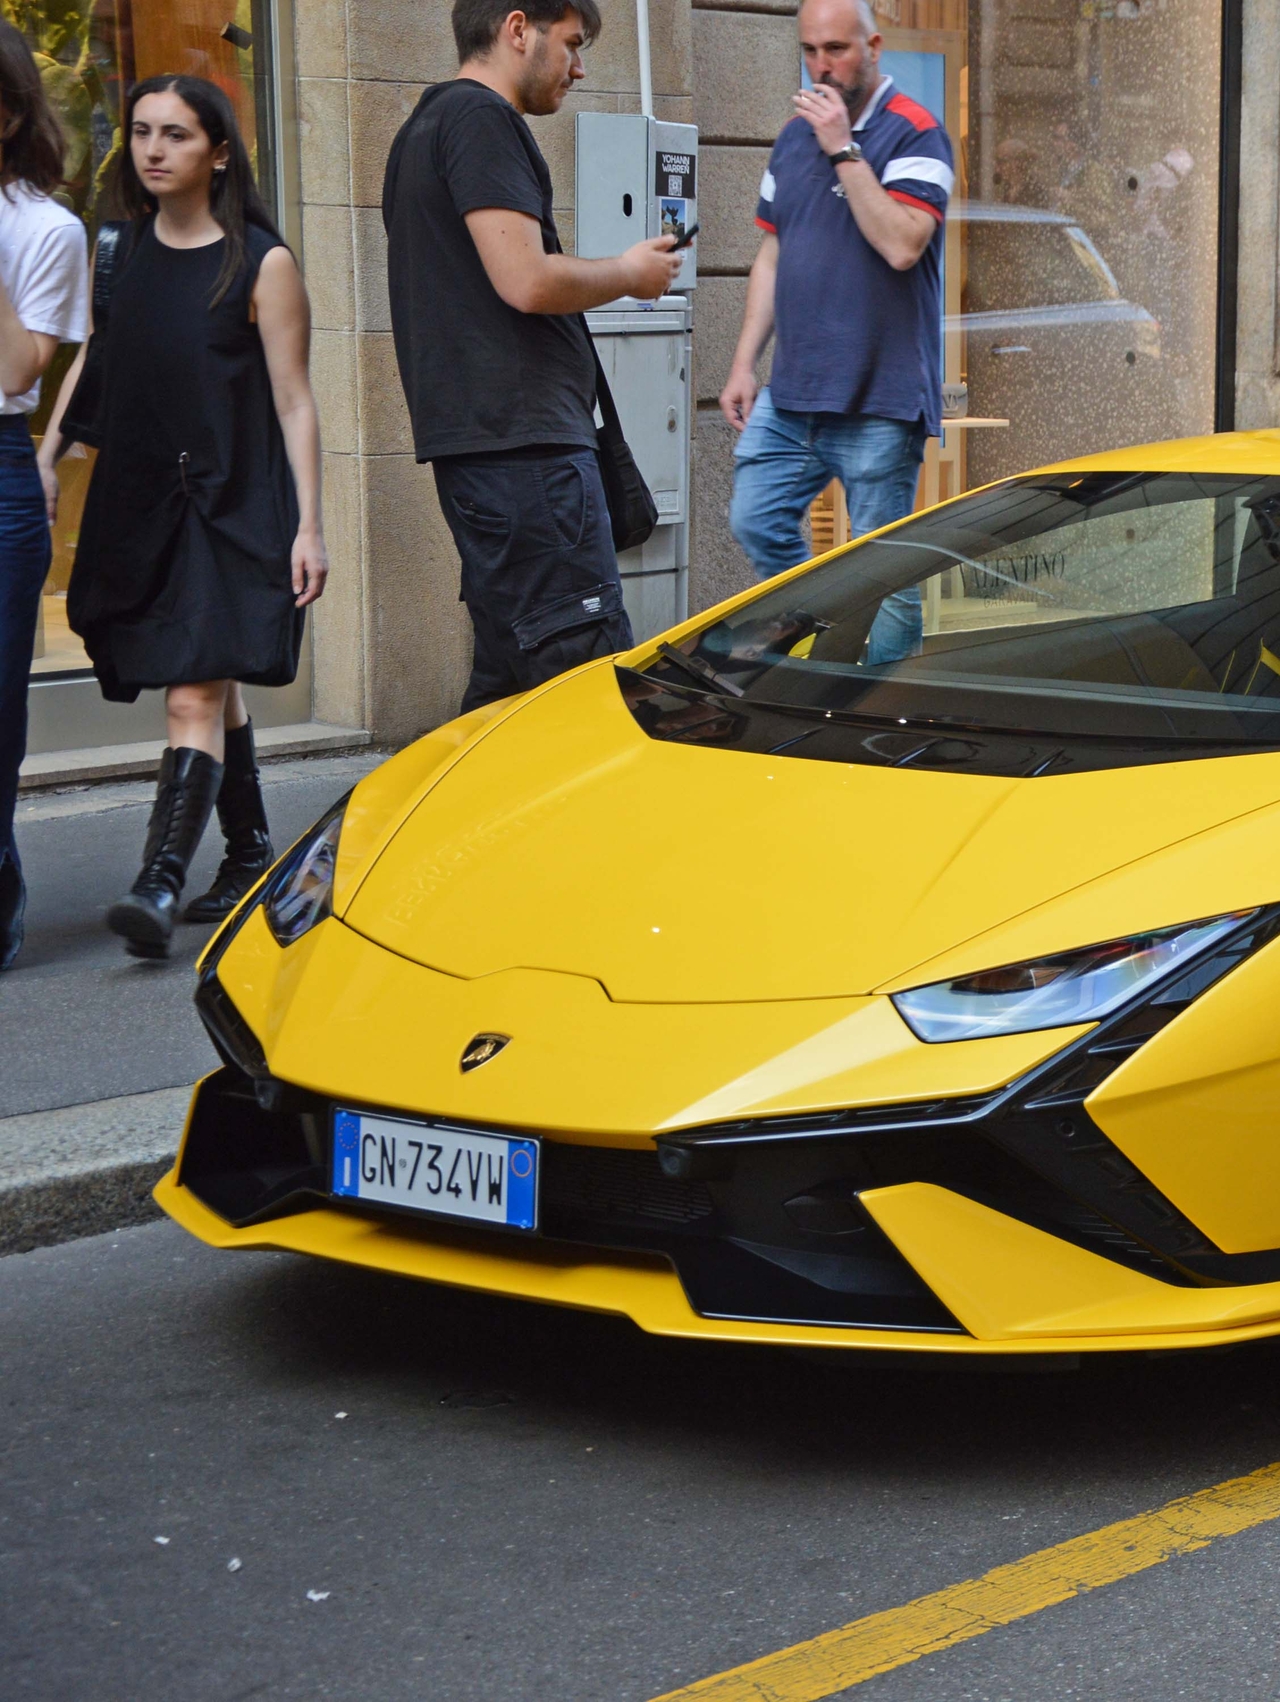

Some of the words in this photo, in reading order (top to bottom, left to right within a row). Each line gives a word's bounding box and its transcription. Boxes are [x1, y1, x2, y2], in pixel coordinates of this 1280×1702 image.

[662, 153, 690, 165] YOHANN
[662, 163, 690, 175] WARREN
[959, 552, 1066, 590] VALENTINO
